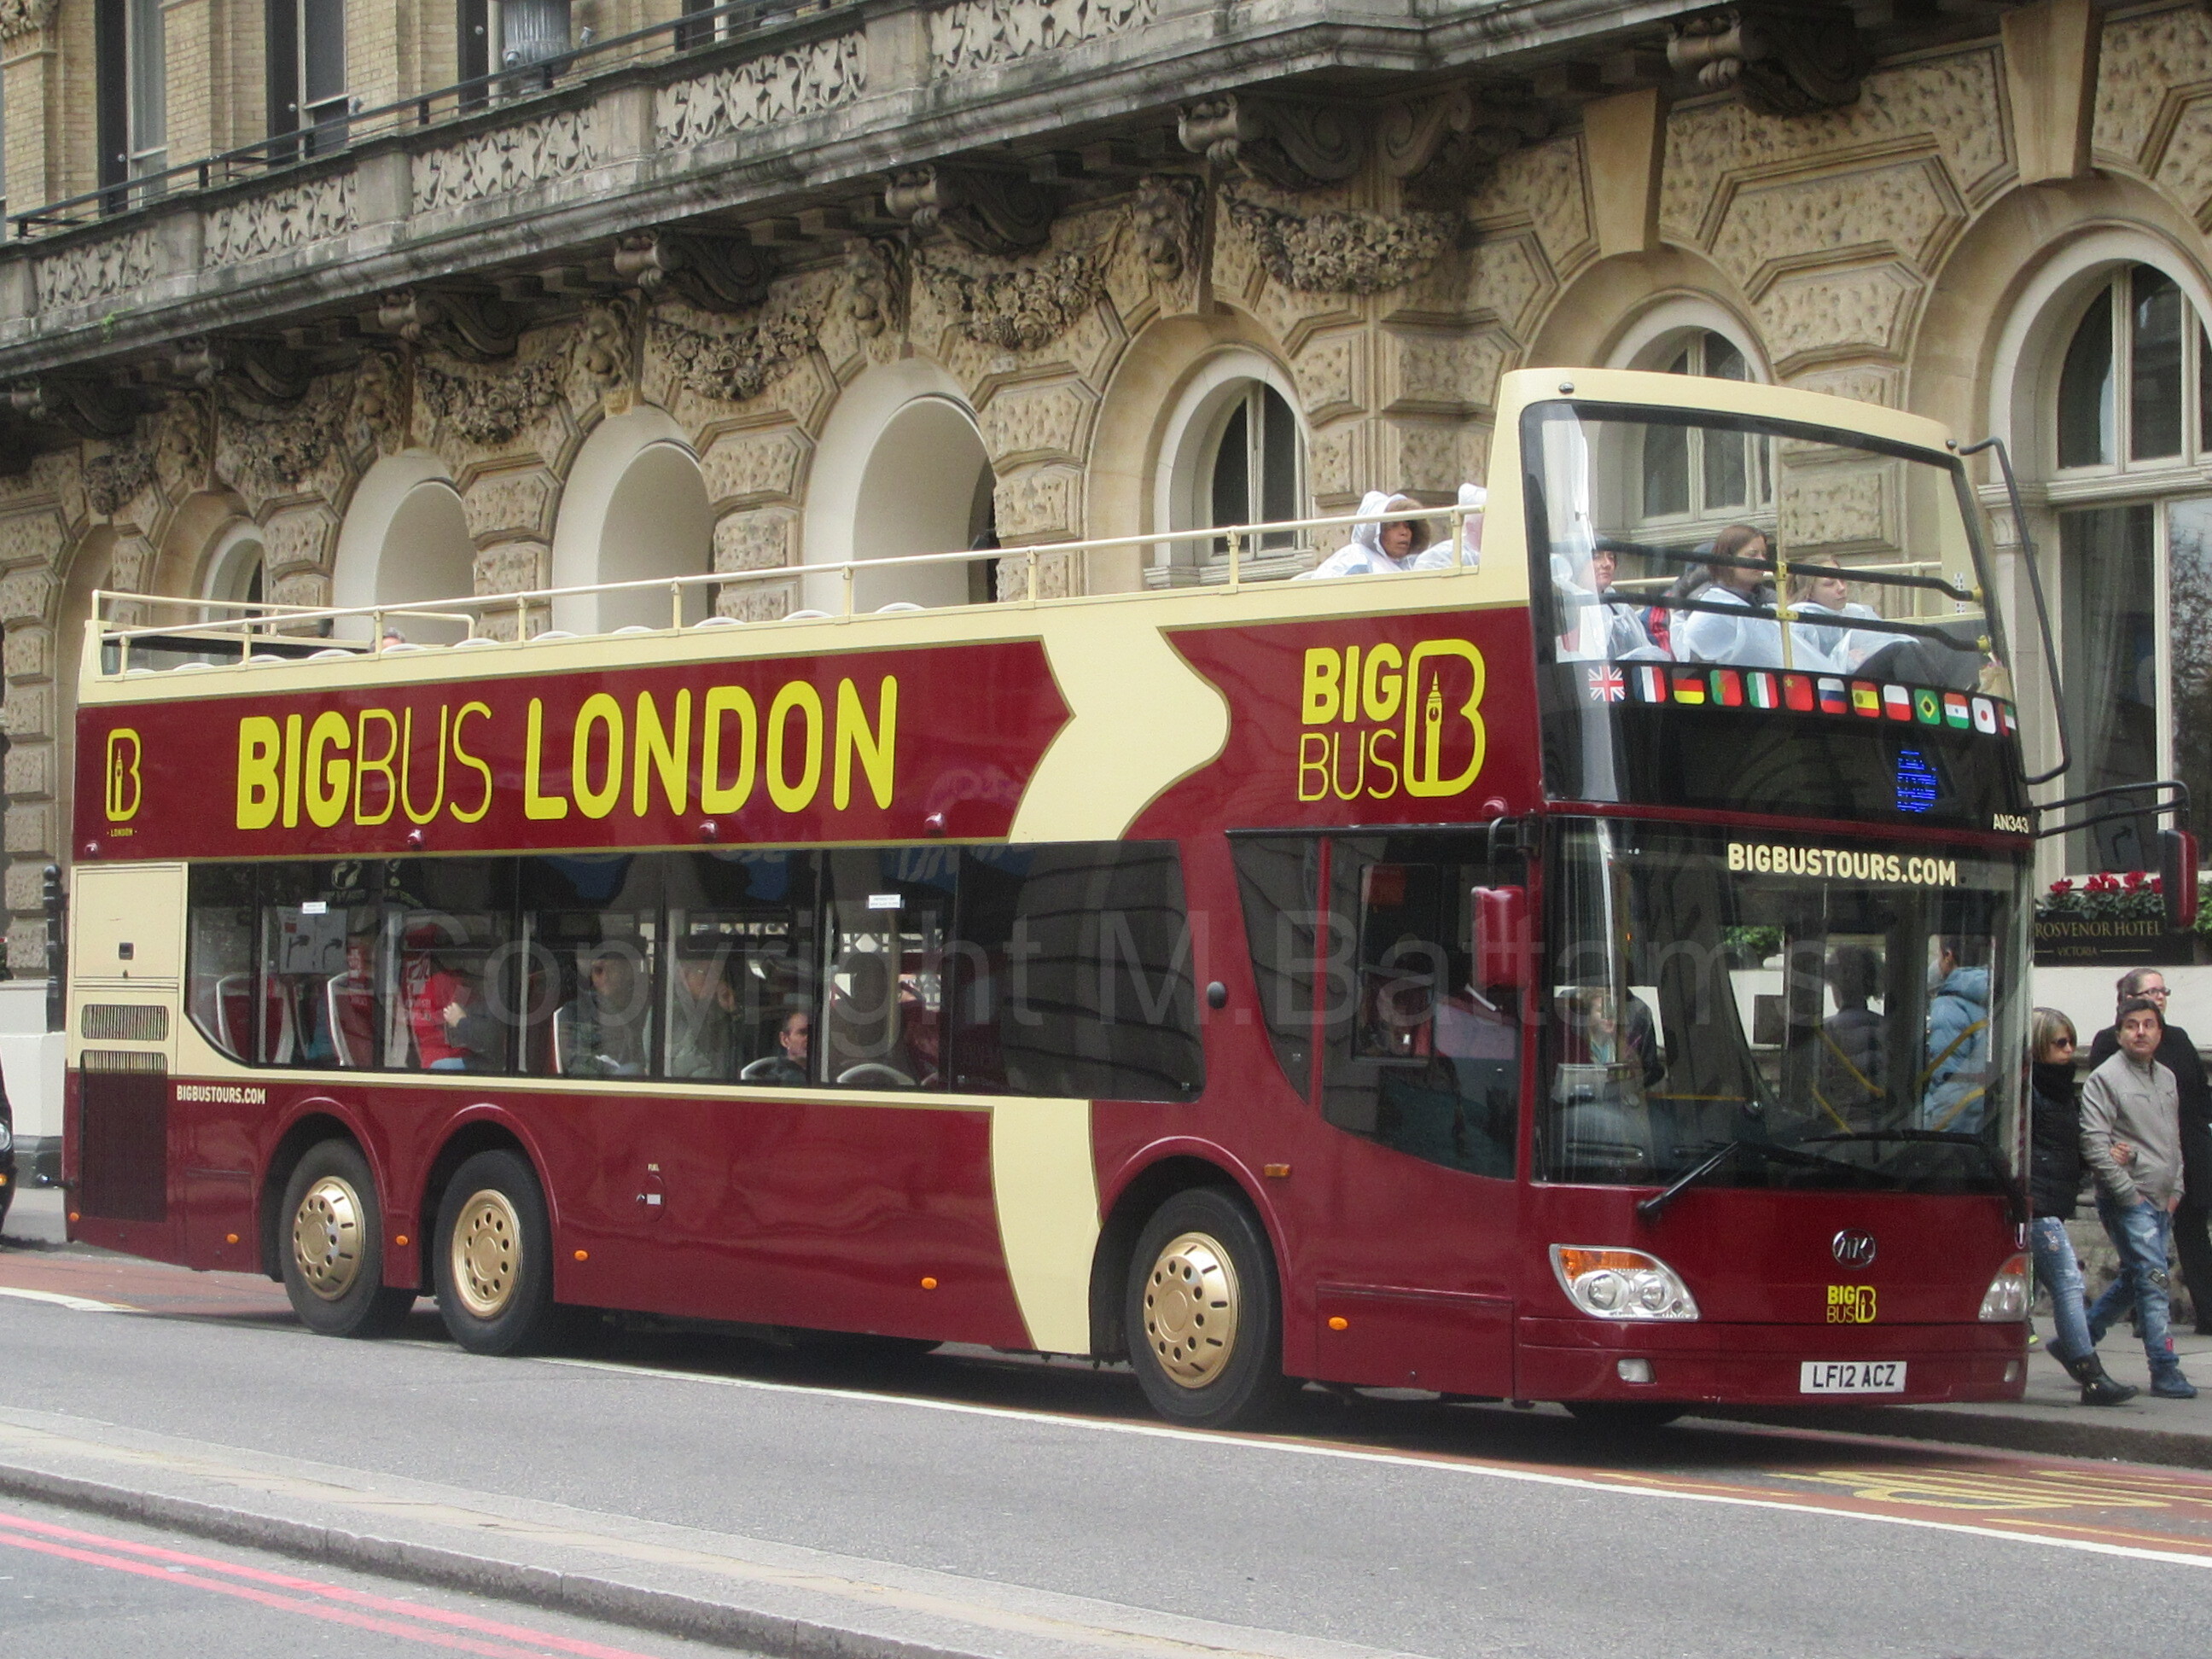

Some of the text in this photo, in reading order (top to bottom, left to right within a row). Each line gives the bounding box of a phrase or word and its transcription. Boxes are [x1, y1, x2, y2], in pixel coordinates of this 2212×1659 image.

[1302, 643, 1403, 725] BIG
[524, 675, 898, 819] LONDON
[1298, 729, 1399, 801] BUS
[1992, 813, 2029, 834] AN343
[1728, 842, 1957, 888] BIGBUSTOURS.COM
[2034, 920, 2161, 939] ROSVENOR HOTEL
[2057, 946, 2098, 957] VICTORIA
[176, 1084, 267, 1105] BIGBUSTOURS.COM
[1827, 1285, 1855, 1305] BIG
[1826, 1306, 1855, 1323] BUS
[1813, 1365, 1897, 1388] LF12 ACZ
